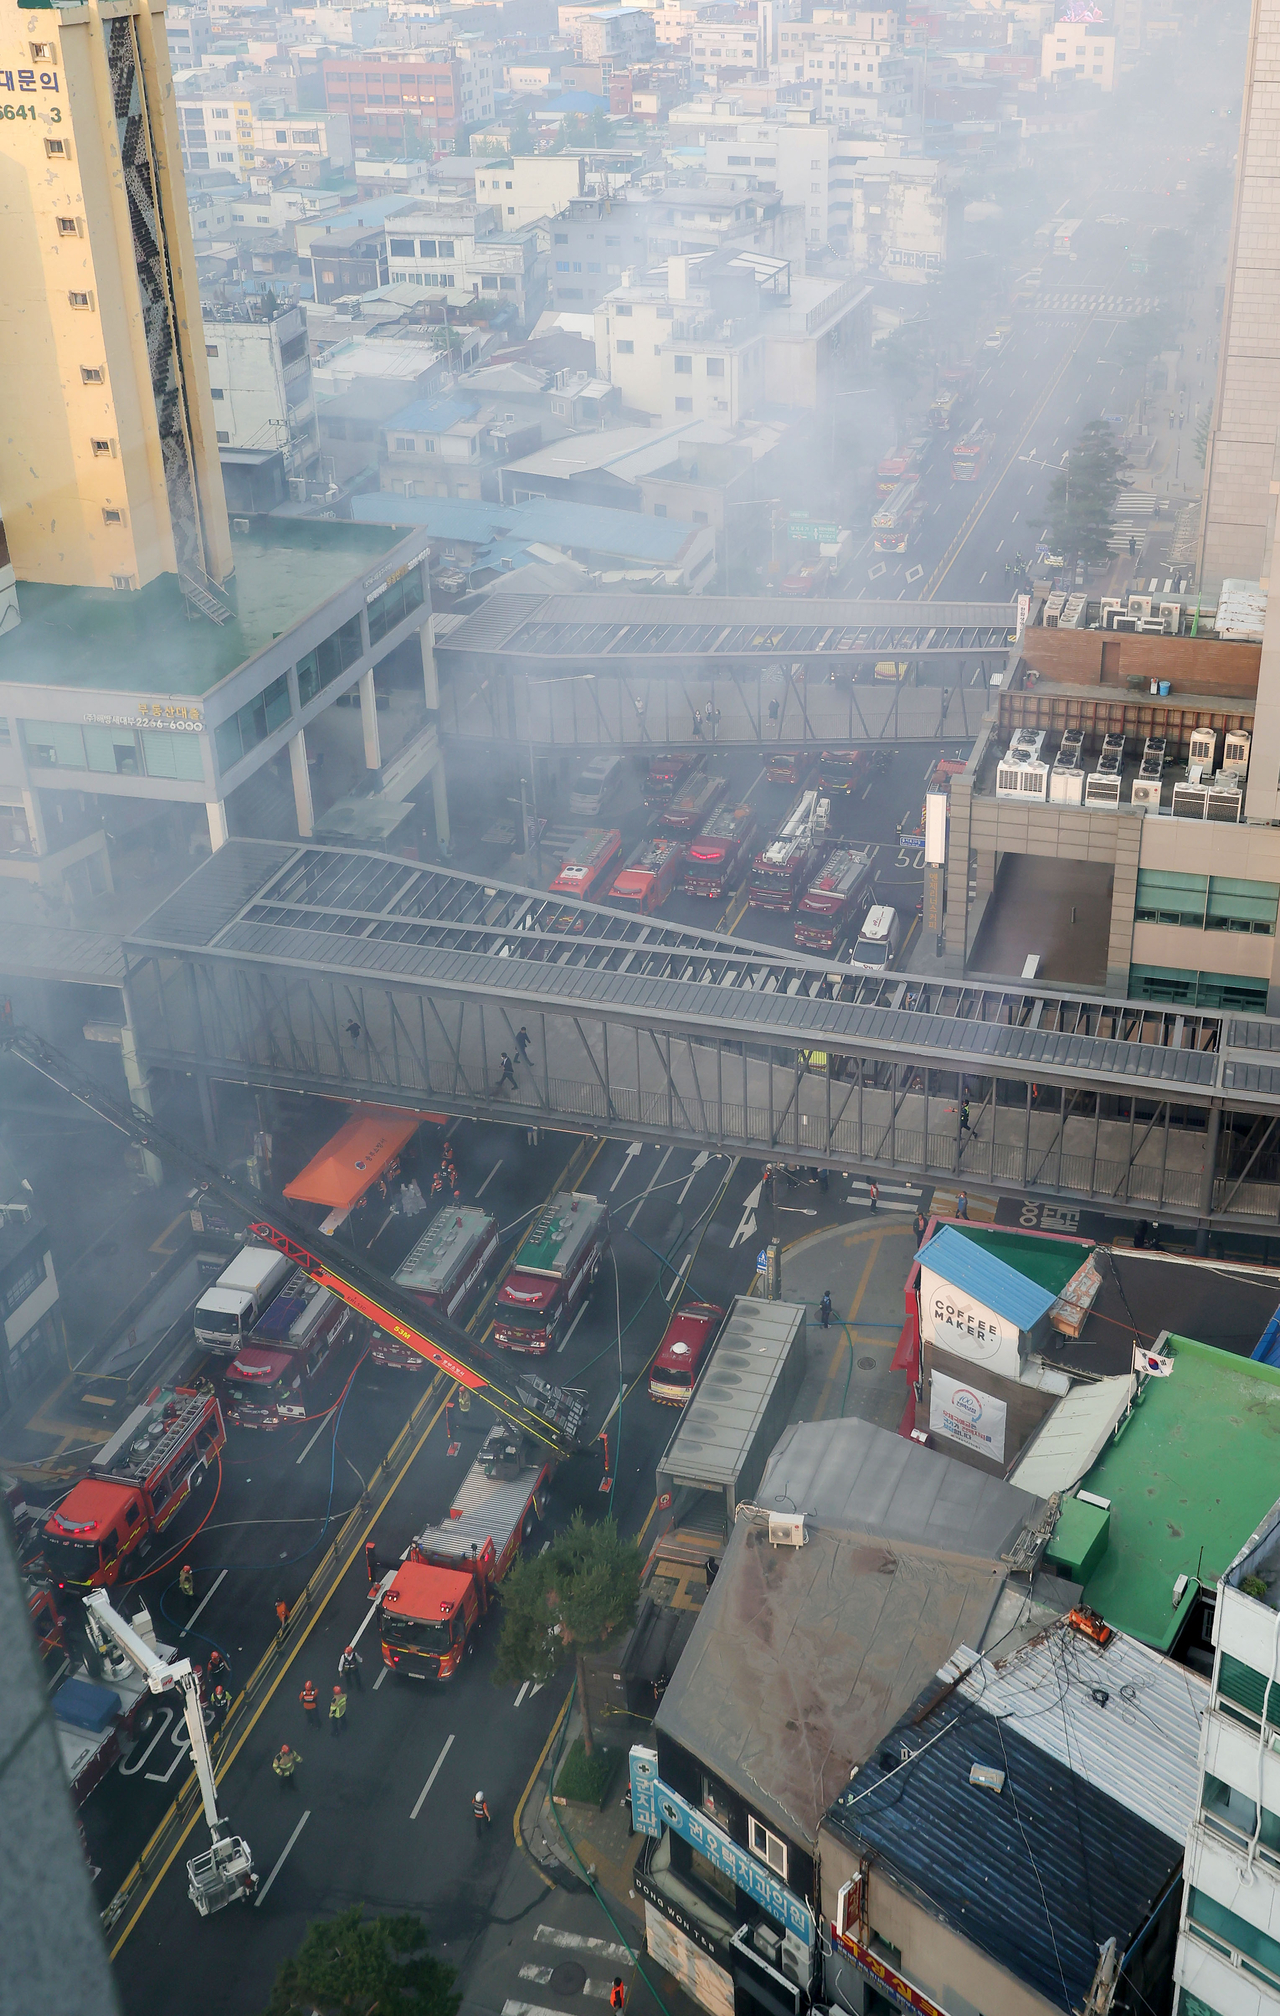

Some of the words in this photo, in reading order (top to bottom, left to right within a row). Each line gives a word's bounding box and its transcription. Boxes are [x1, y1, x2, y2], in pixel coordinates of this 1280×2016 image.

[136, 717, 203, 732] 2266-6000
[393, 1325, 411, 1340] 53M
[935, 1300, 997, 1336] COFFEE
[635, 1775, 658, 1828] 권치과
[688, 1816, 806, 1933] 권오택치과의원
[635, 1878, 664, 1908] DONG
[667, 1902, 690, 1931] WON
